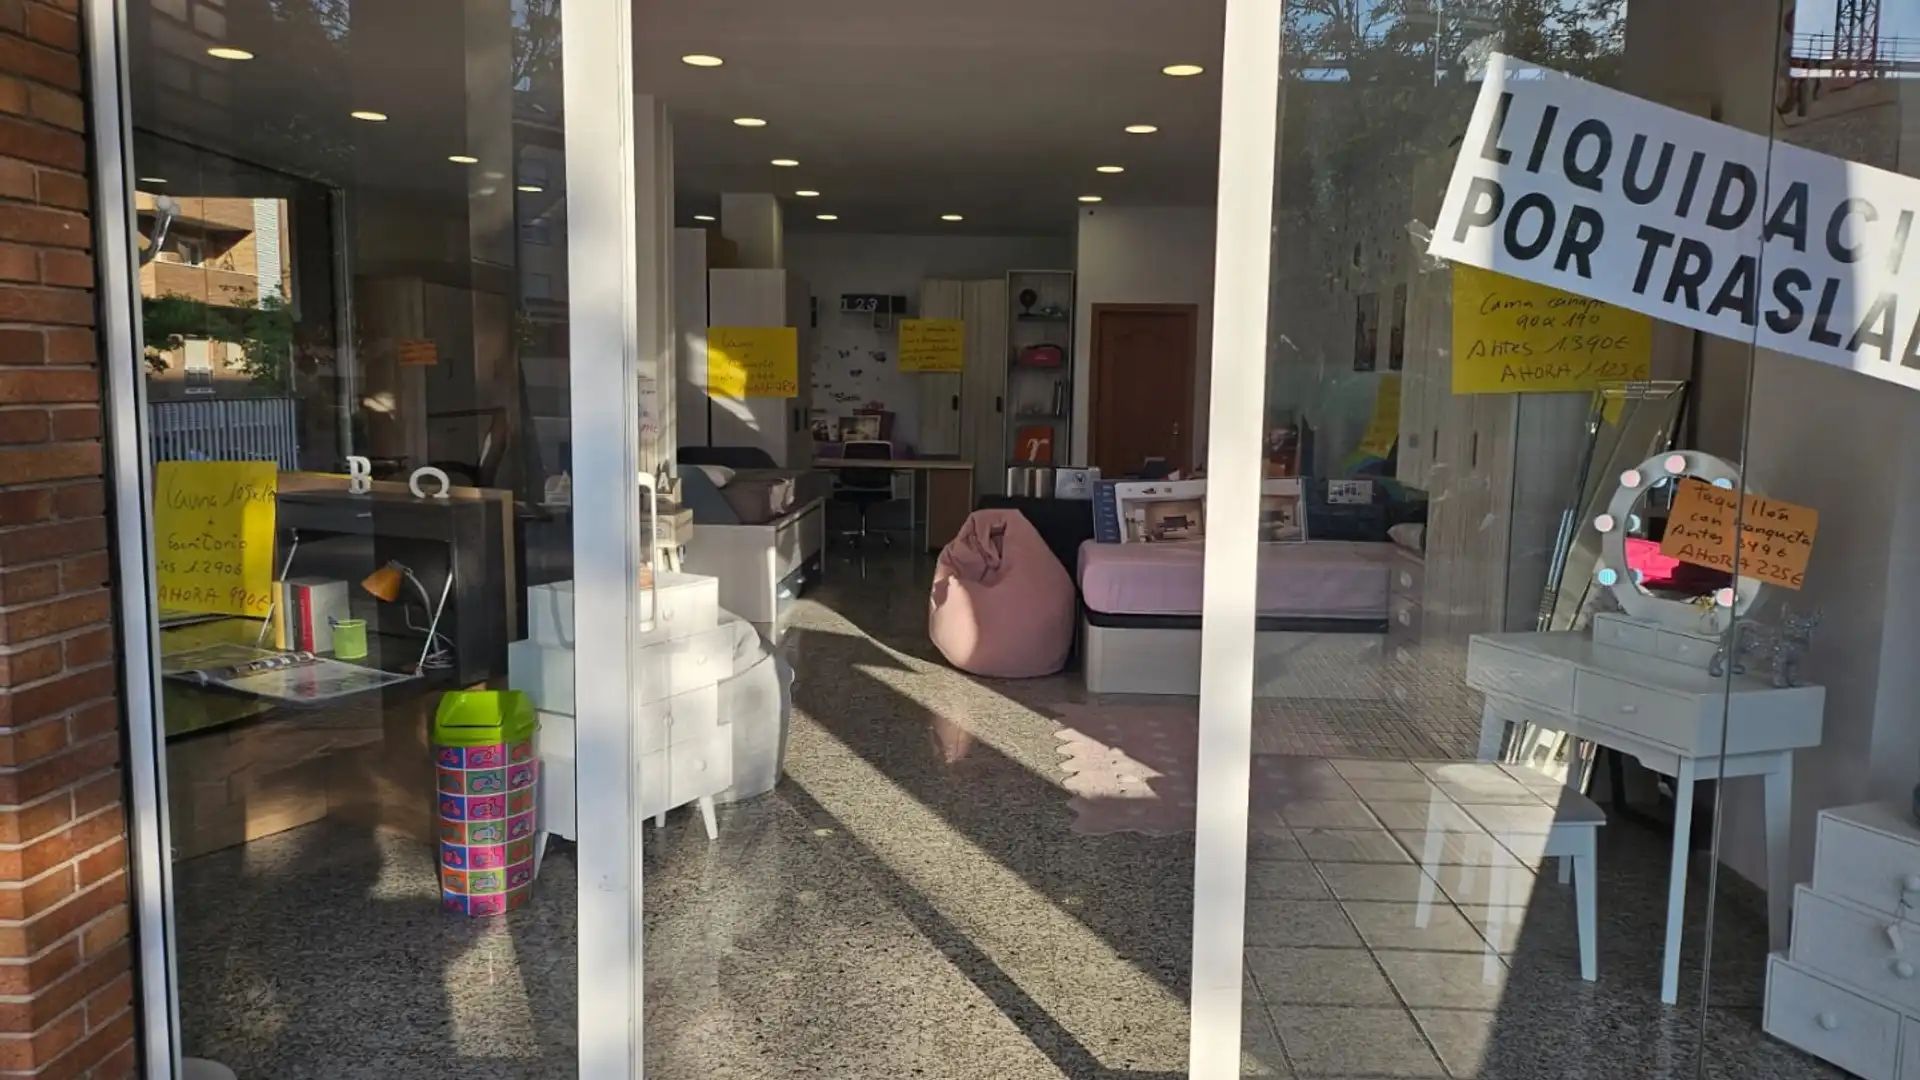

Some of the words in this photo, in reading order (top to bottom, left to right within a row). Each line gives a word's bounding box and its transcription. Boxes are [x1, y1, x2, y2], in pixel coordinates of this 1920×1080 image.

[1452, 177, 1604, 280] POR
[1500, 363, 1572, 383] AHORA
[1757, 559, 1805, 586] 225€
[158, 585, 220, 606] AHORA
